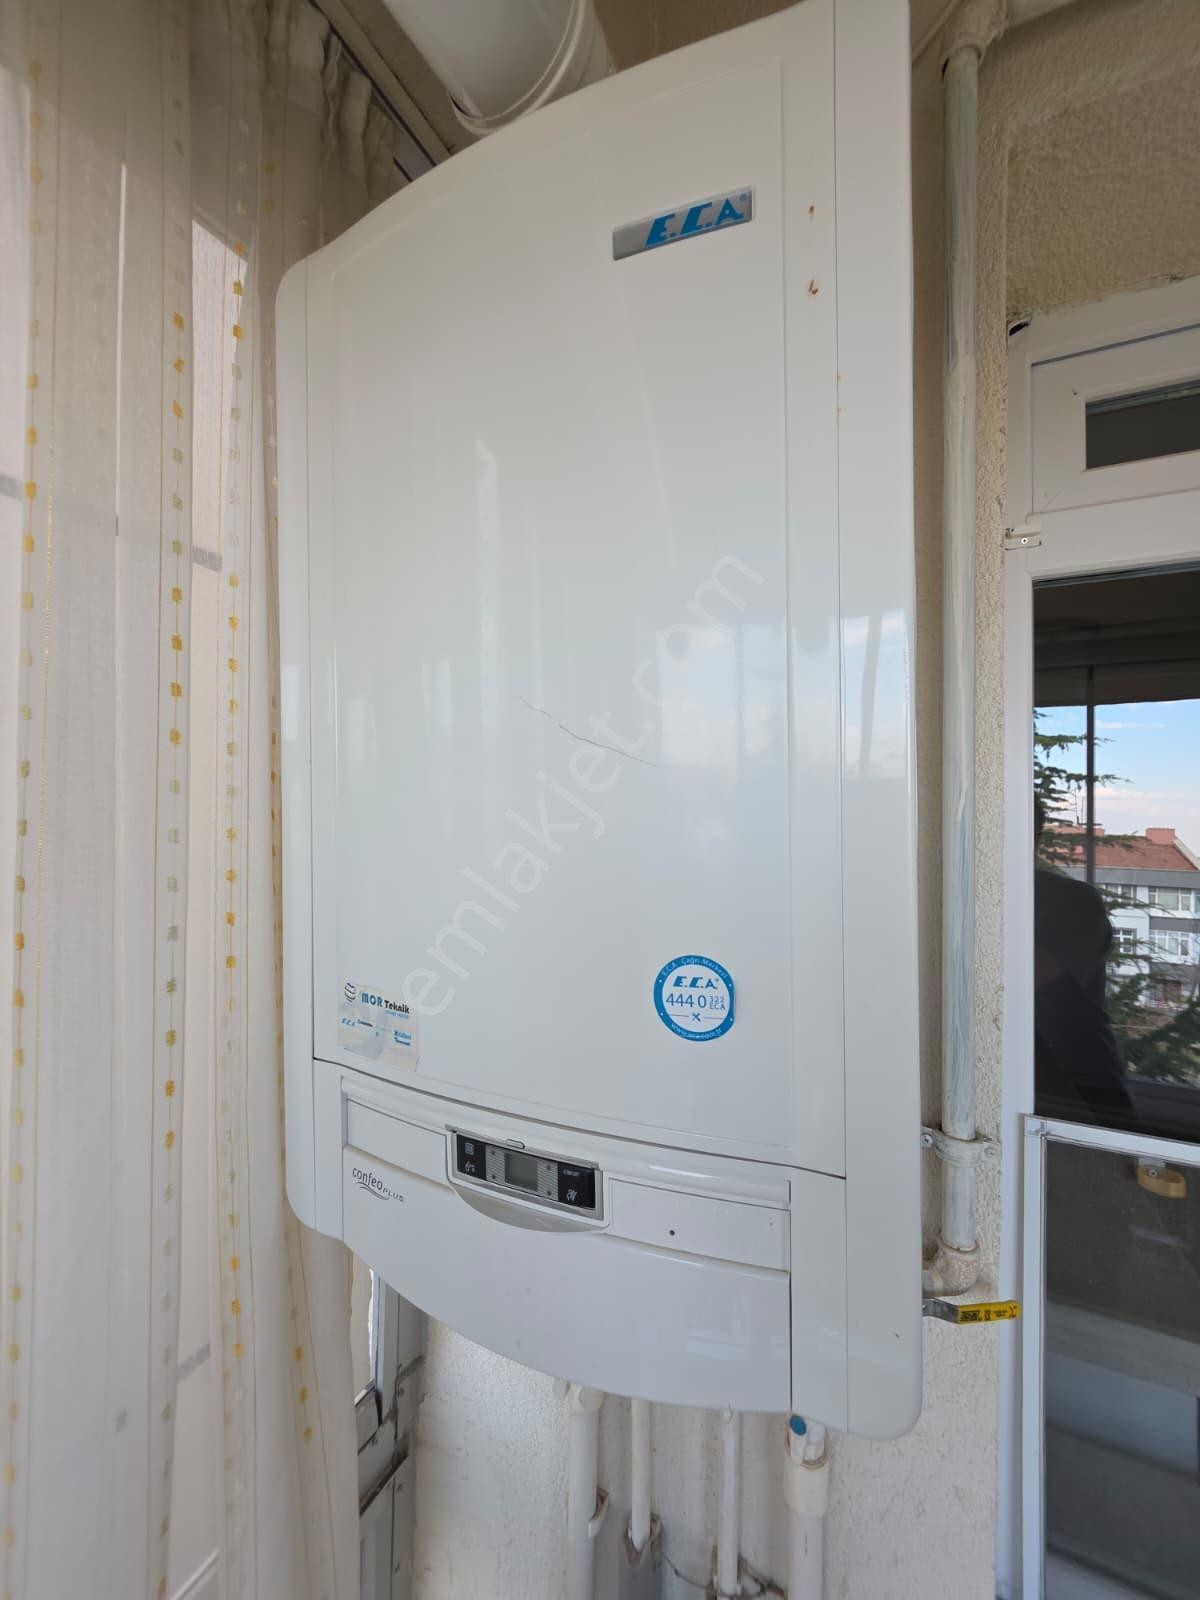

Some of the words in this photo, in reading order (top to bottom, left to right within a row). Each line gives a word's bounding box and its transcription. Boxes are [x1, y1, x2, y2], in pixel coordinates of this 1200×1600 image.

[361, 992, 383, 1007] MOR
[384, 1000, 410, 1014] Teknik
[665, 993, 694, 1007] 444
